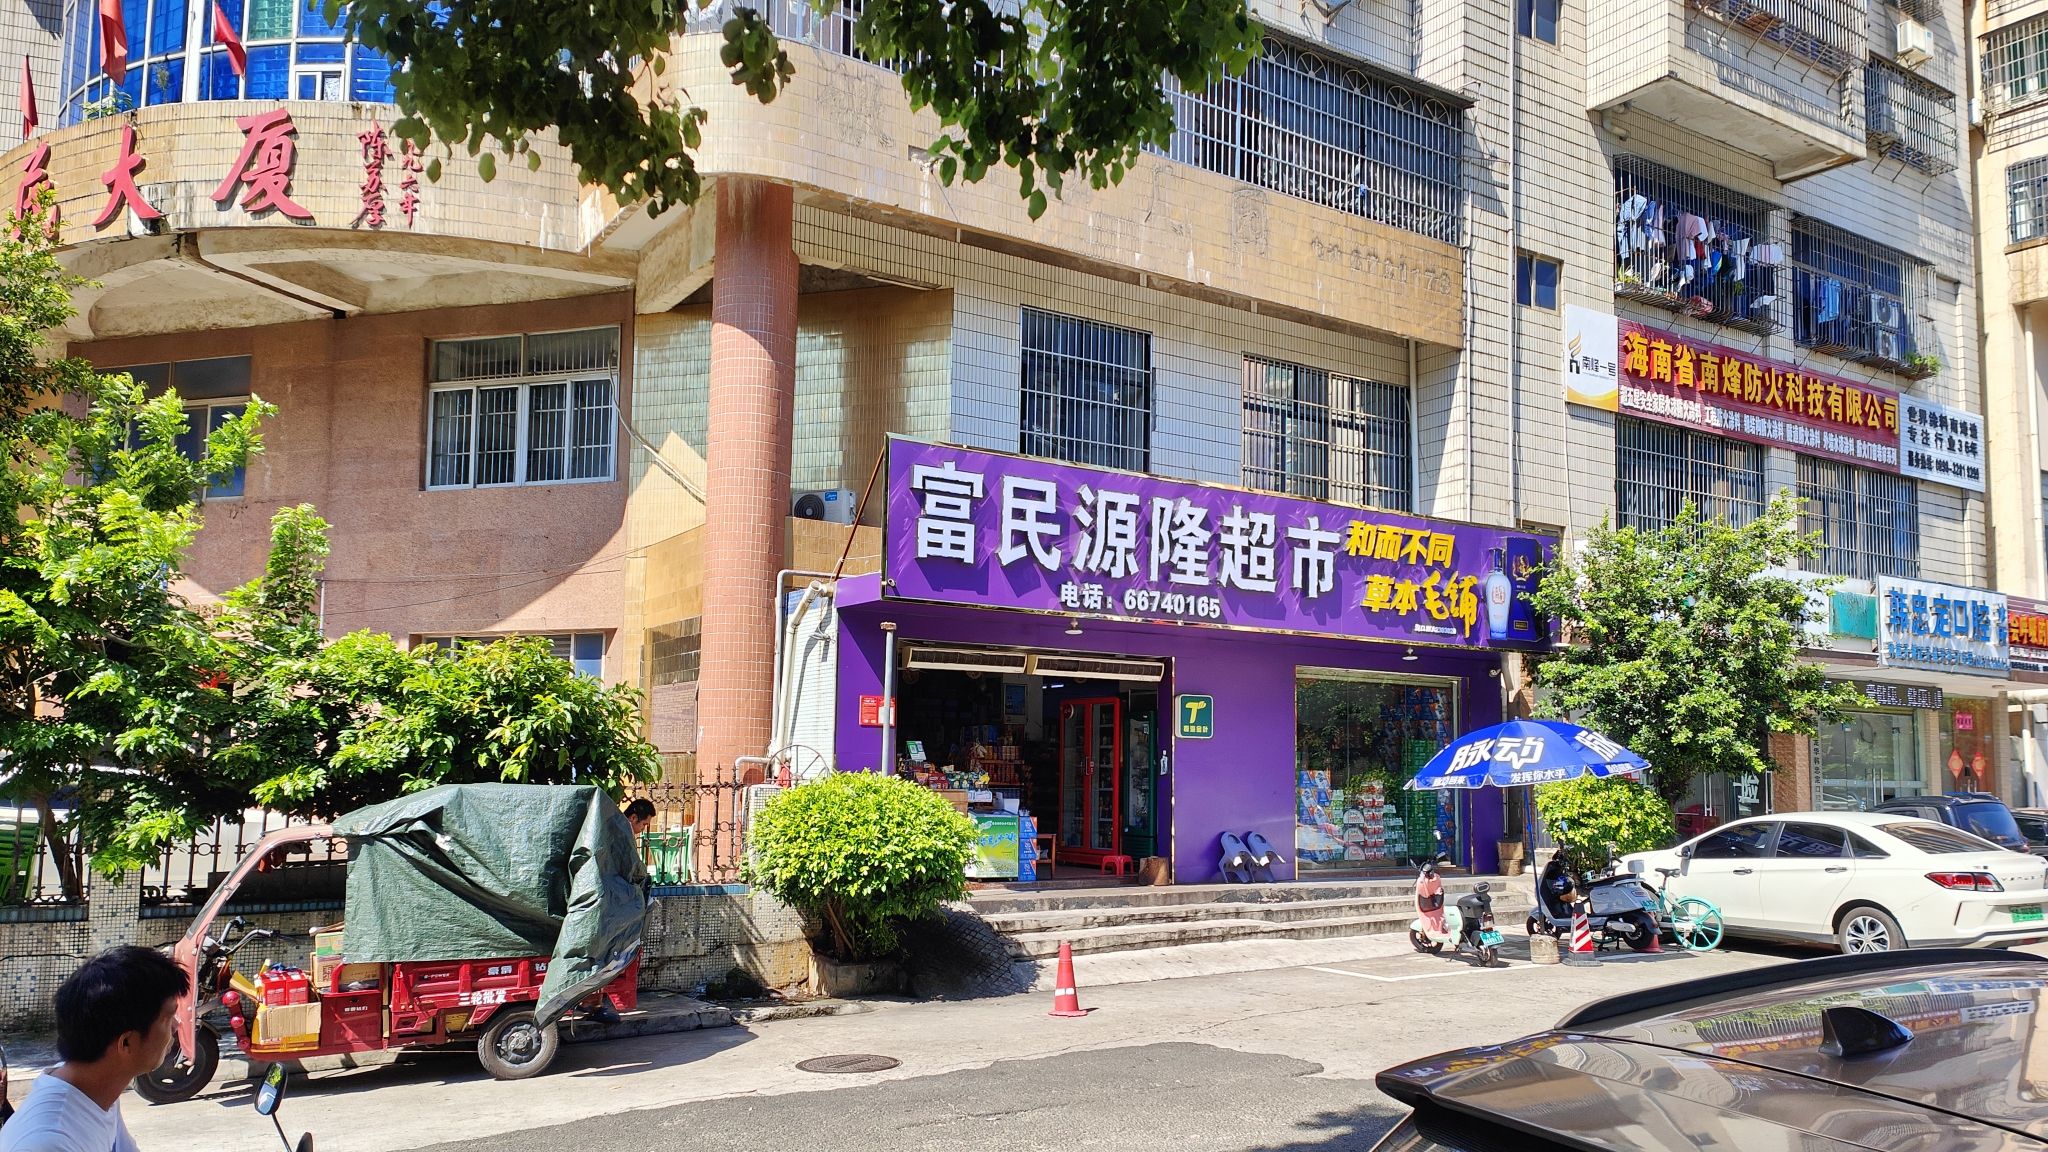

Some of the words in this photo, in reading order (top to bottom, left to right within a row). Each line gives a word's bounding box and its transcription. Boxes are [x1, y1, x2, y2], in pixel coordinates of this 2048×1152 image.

[1582, 356, 1616, 377] 南烽一号
[1624, 331, 1899, 436] 海南省南烽防火科技有限公司
[1907, 425, 1978, 459] 专注行业36年
[911, 461, 1342, 599] 富民源隆超市
[1343, 519, 1455, 568] 和而不同
[1361, 570, 1478, 638] 草本毛铺
[1445, 736, 1545, 775] 脉动
[1510, 768, 1567, 784] 发挥你水平
[458, 989, 507, 1006] 三轮批发
